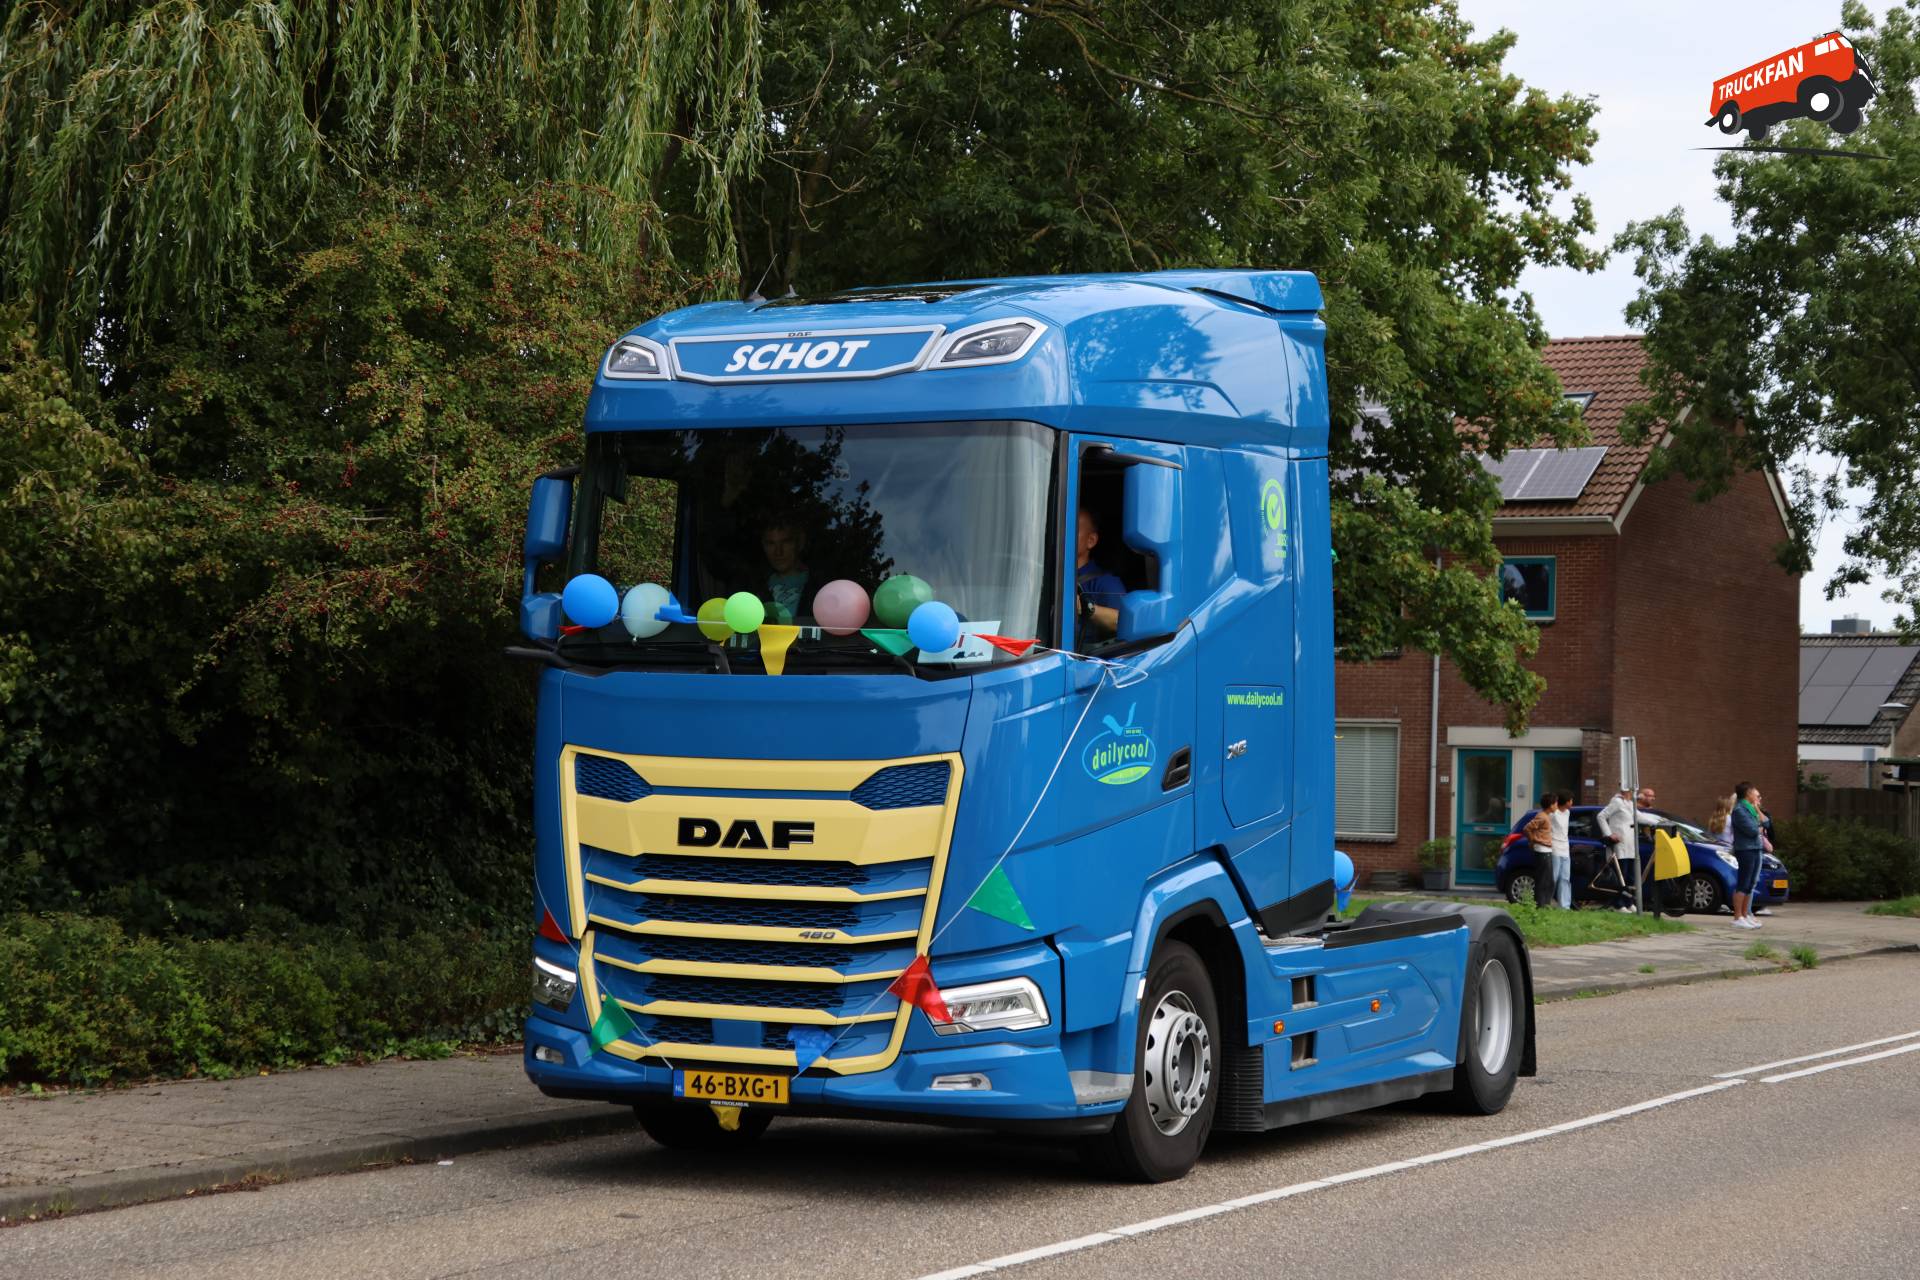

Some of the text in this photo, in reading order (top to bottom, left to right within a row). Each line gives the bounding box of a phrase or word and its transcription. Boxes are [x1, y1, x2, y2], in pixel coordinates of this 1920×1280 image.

[724, 340, 871, 372] SCHOT
[1227, 691, 1283, 708] www.dailycool.nl
[1092, 738, 1149, 771] dailycool
[677, 817, 815, 850] DAF
[799, 931, 835, 940] 480
[691, 1074, 779, 1098] 46-BXG-1
